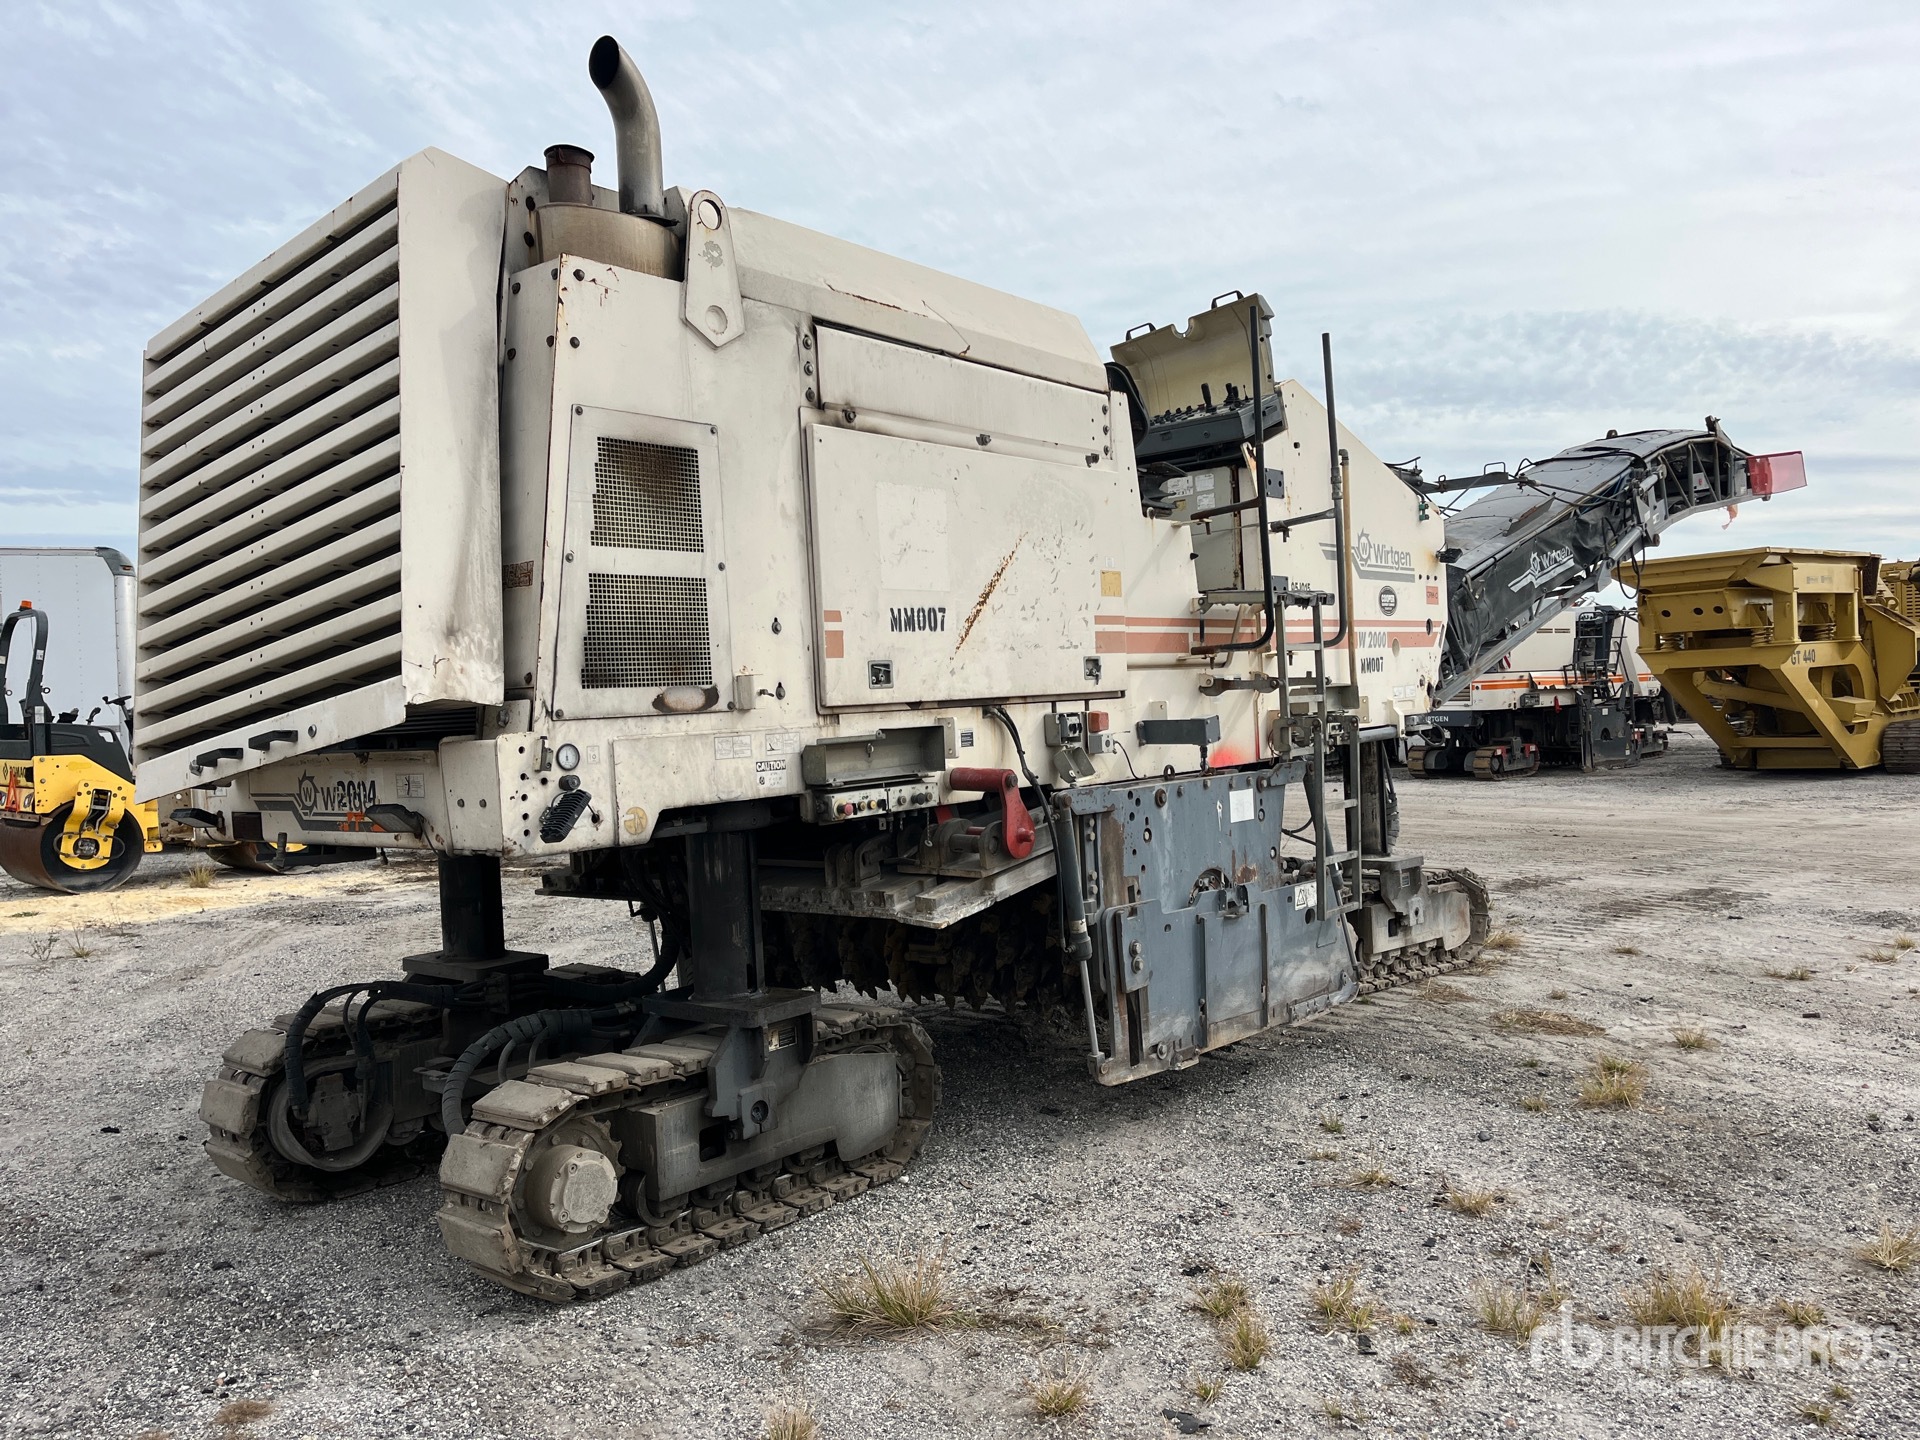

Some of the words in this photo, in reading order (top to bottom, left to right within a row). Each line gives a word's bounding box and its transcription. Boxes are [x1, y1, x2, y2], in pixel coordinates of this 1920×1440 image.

[1373, 543, 1412, 570] Wirtgen
[890, 607, 947, 632] MM007
[1358, 632, 1367, 648] W
[1368, 632, 1387, 648] 2000
[1360, 656, 1384, 673] MM007
[1791, 650, 1801, 665] GT
[1803, 649, 1816, 663] 440
[756, 760, 786, 771] CAUTION
